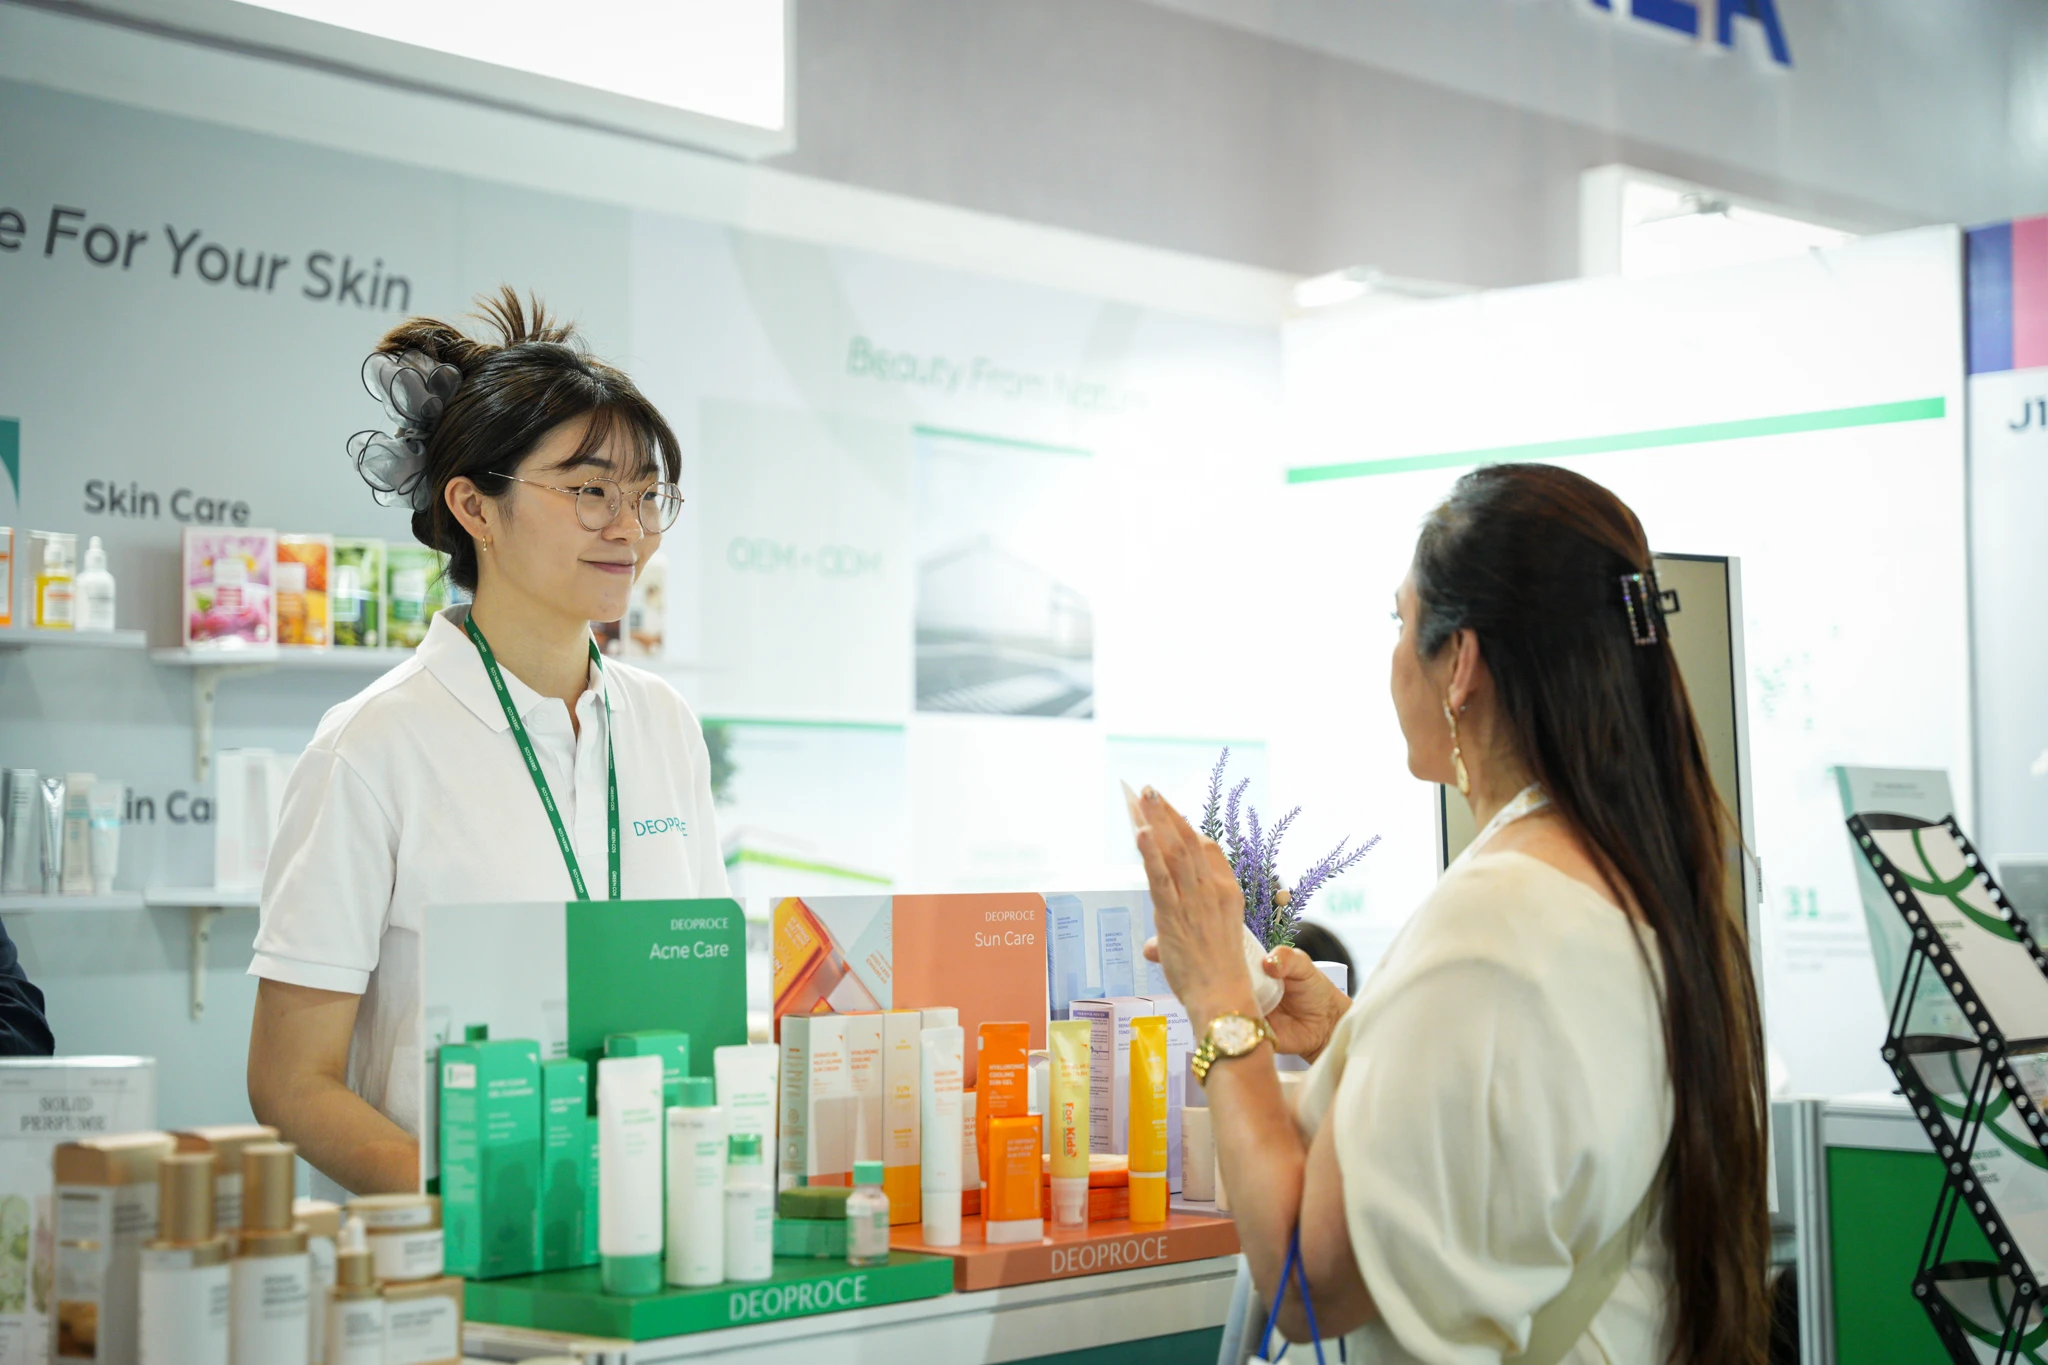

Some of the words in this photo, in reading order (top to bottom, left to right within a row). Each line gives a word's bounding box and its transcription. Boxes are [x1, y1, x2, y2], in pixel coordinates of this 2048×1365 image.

[44, 203, 148, 272] For
[163, 222, 290, 295] Your
[302, 249, 412, 314] Skin
[847, 334, 960, 396] Beauty
[84, 479, 160, 519] Skin
[170, 488, 251, 526] Care
[121, 787, 155, 826] in
[166, 789, 217, 826] Ca
[670, 917, 729, 931] DEOPROCE
[985, 910, 1035, 922] DEOPROCE
[975, 931, 1001, 947] Sun
[1004, 931, 1035, 946] Care
[649, 943, 690, 960] Acne
[693, 941, 729, 958] Care
[39, 1096, 94, 1112] SOLID
[1065, 1102, 1074, 1124] For
[20, 1115, 106, 1131] PERFUME
[1051, 1236, 1169, 1275] DEOPROCE
[729, 1275, 869, 1322] DEOPROCE
